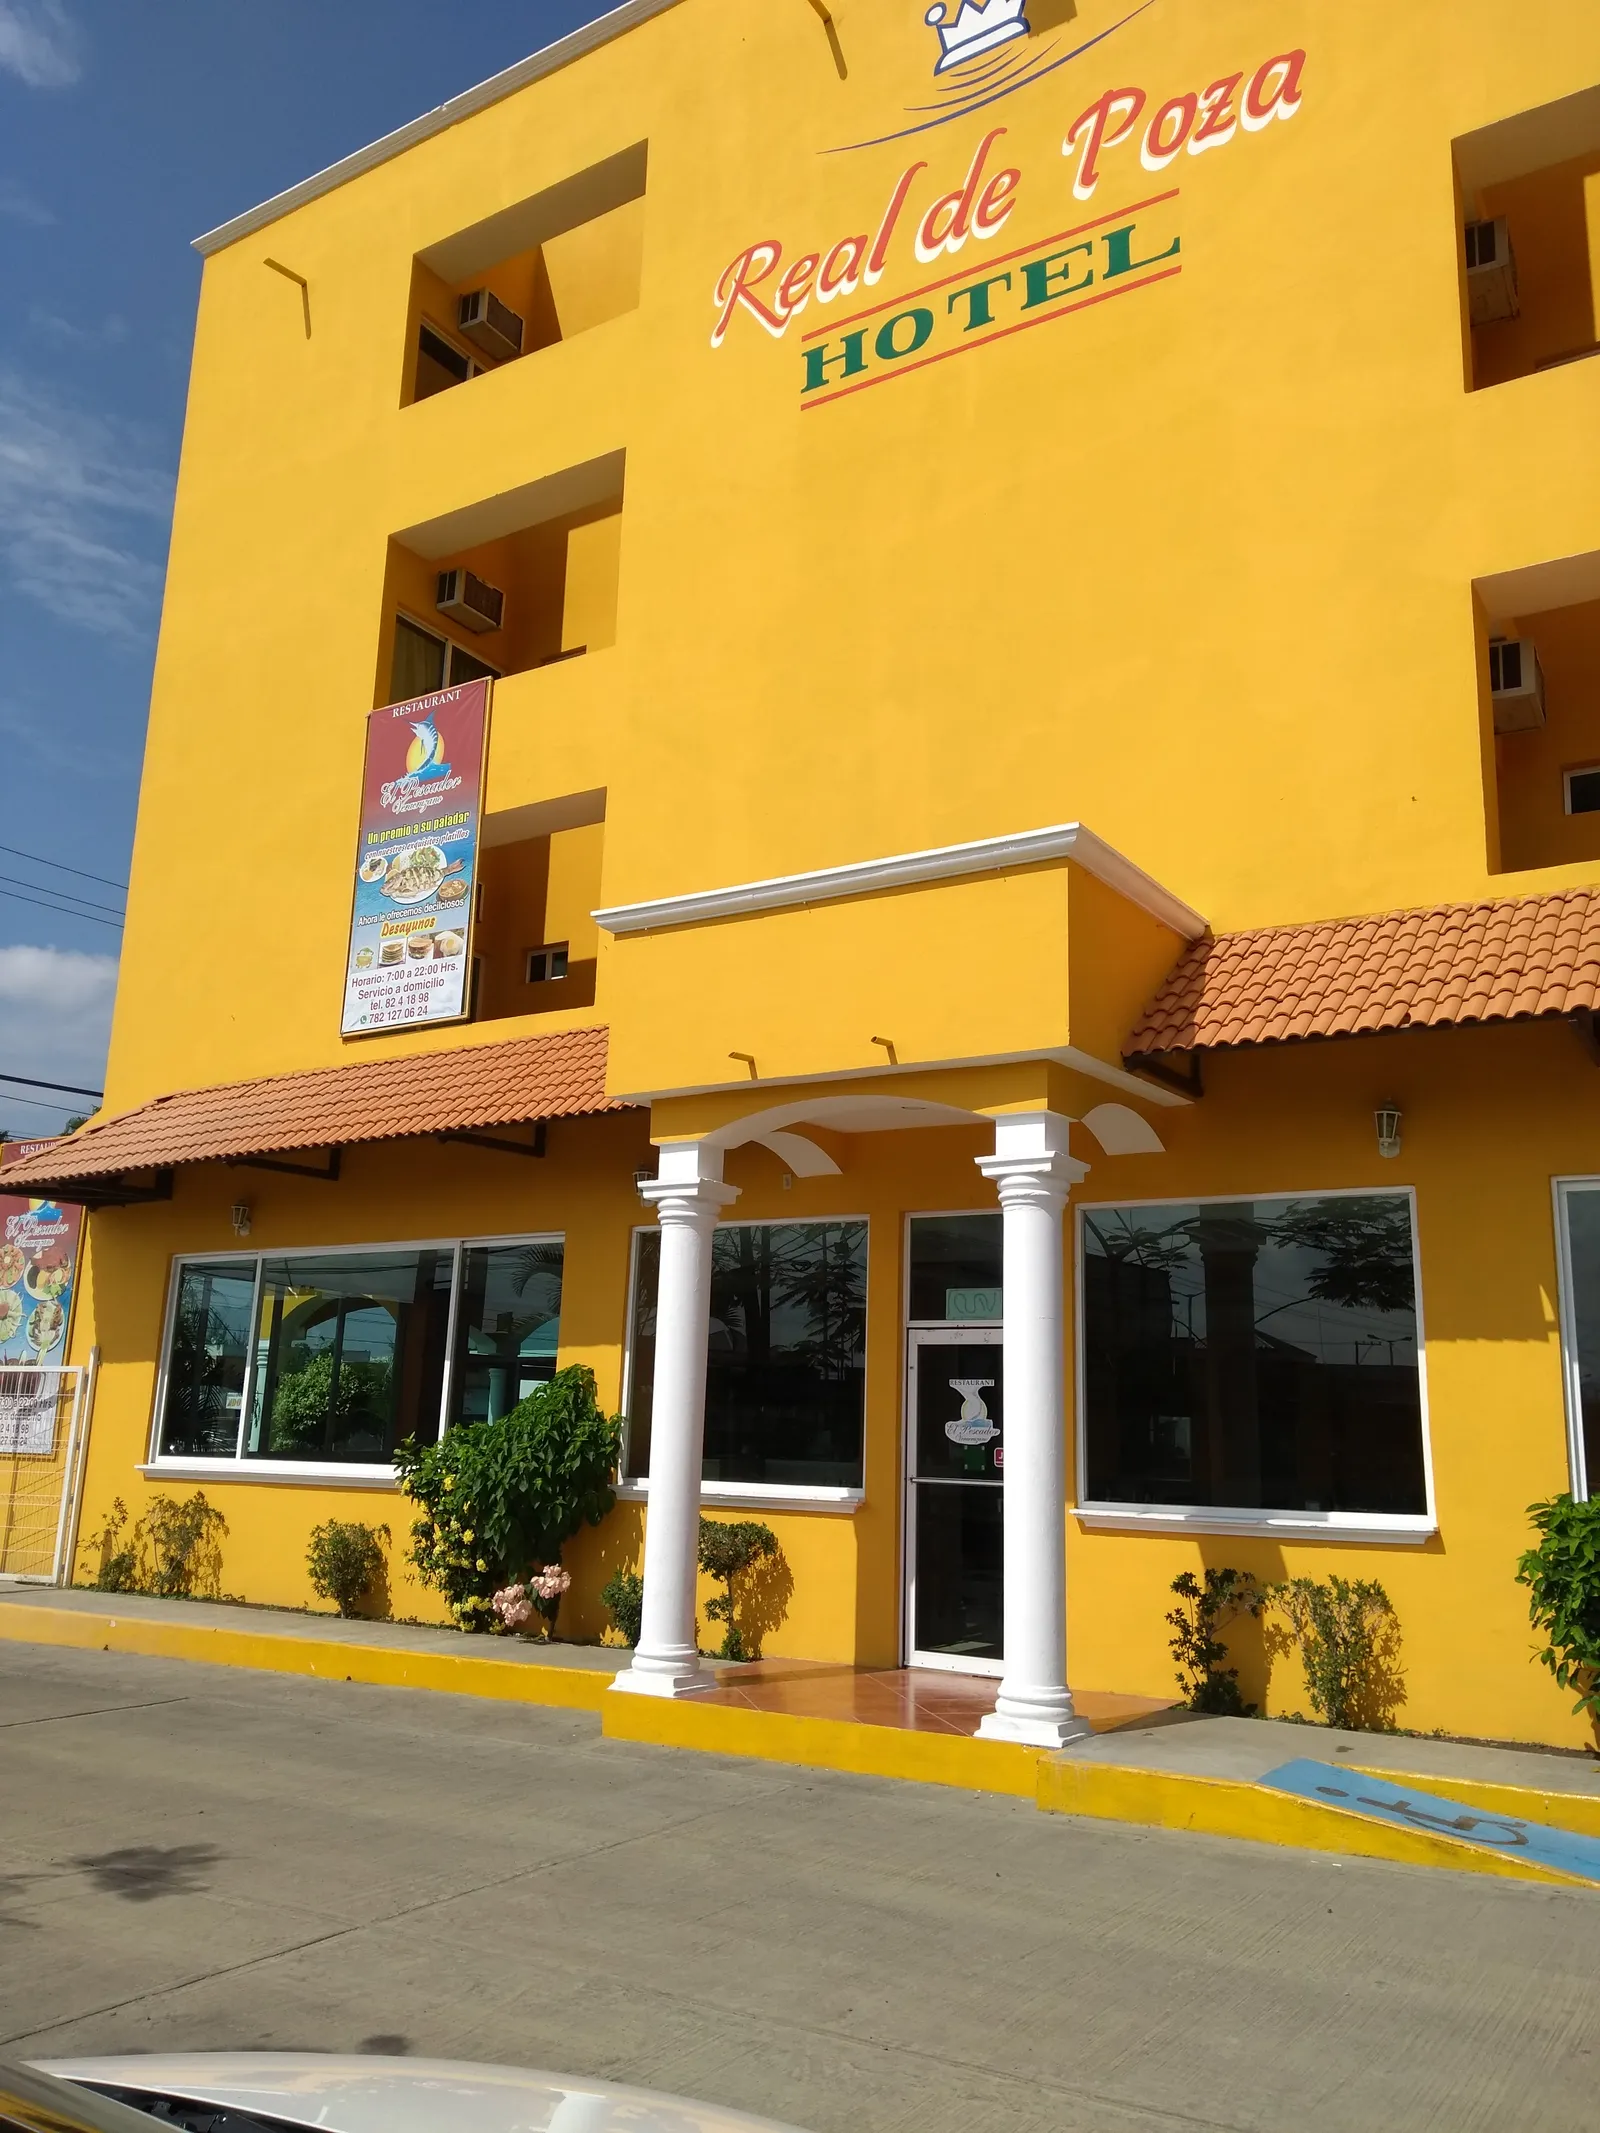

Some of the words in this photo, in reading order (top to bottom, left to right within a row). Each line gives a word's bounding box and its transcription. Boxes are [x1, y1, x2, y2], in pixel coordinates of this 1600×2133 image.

[711, 161, 928, 348] Real
[914, 127, 1021, 264] de
[1061, 48, 1307, 201] Poza
[800, 224, 1181, 394] HOTEL
[392, 689, 462, 718] RESTAURANT
[380, 781, 400, 808] El
[399, 770, 462, 800] Pescador
[367, 832, 378, 845] Un
[380, 824, 411, 843] premio
[413, 822, 419, 834] a
[421, 819, 432, 832] su
[433, 811, 470, 829] paladar
[440, 828, 470, 846] platillos
[358, 914, 378, 926] Ahora
[379, 912, 386, 922] le
[386, 906, 422, 920] ofrecemos
[381, 916, 435, 937] Desayunos
[351, 974, 385, 988] Horario:
[387, 969, 405, 982] 7:00
[406, 970, 412, 978] a
[414, 964, 438, 977] 22:00
[440, 962, 459, 973] Hrs.
[358, 986, 393, 1000] Servicio
[395, 986, 401, 994] a
[403, 977, 445, 992] domicilio
[370, 1001, 383, 1011] tel.
[385, 998, 396, 1008] 82
[397, 996, 403, 1006] 4
[406, 994, 416, 1005] 18
[418, 992, 429, 1003] 98
[369, 1012, 385, 1024] 782
[387, 1009, 402, 1021] 127
[404, 1008, 415, 1019] 06
[417, 1005, 428, 1016] 24
[946, 1423, 959, 1435] El
[960, 1423, 1000, 1435] Pescador
